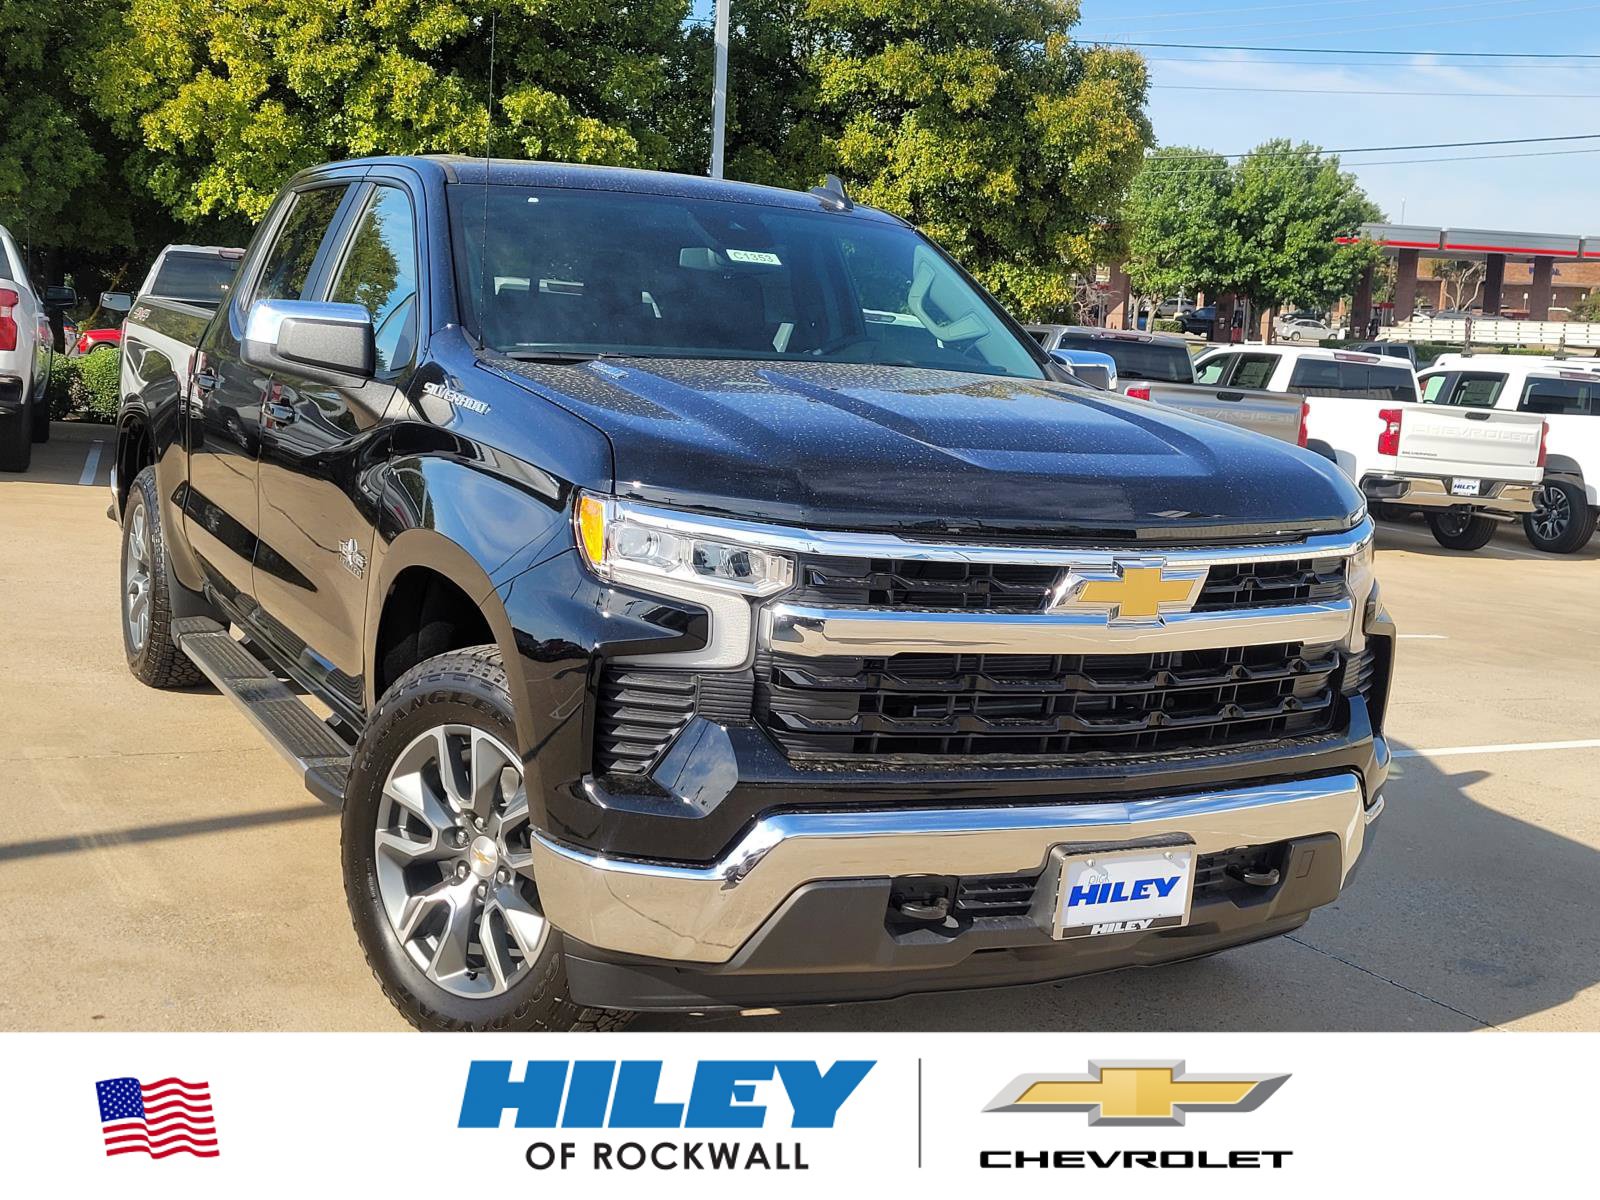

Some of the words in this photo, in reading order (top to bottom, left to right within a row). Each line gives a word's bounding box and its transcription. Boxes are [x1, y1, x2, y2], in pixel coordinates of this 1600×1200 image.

[732, 251, 775, 263] C1353
[422, 382, 491, 415] SILVERADO
[1068, 876, 1182, 907] HILEY
[1090, 918, 1154, 935] HILEY
